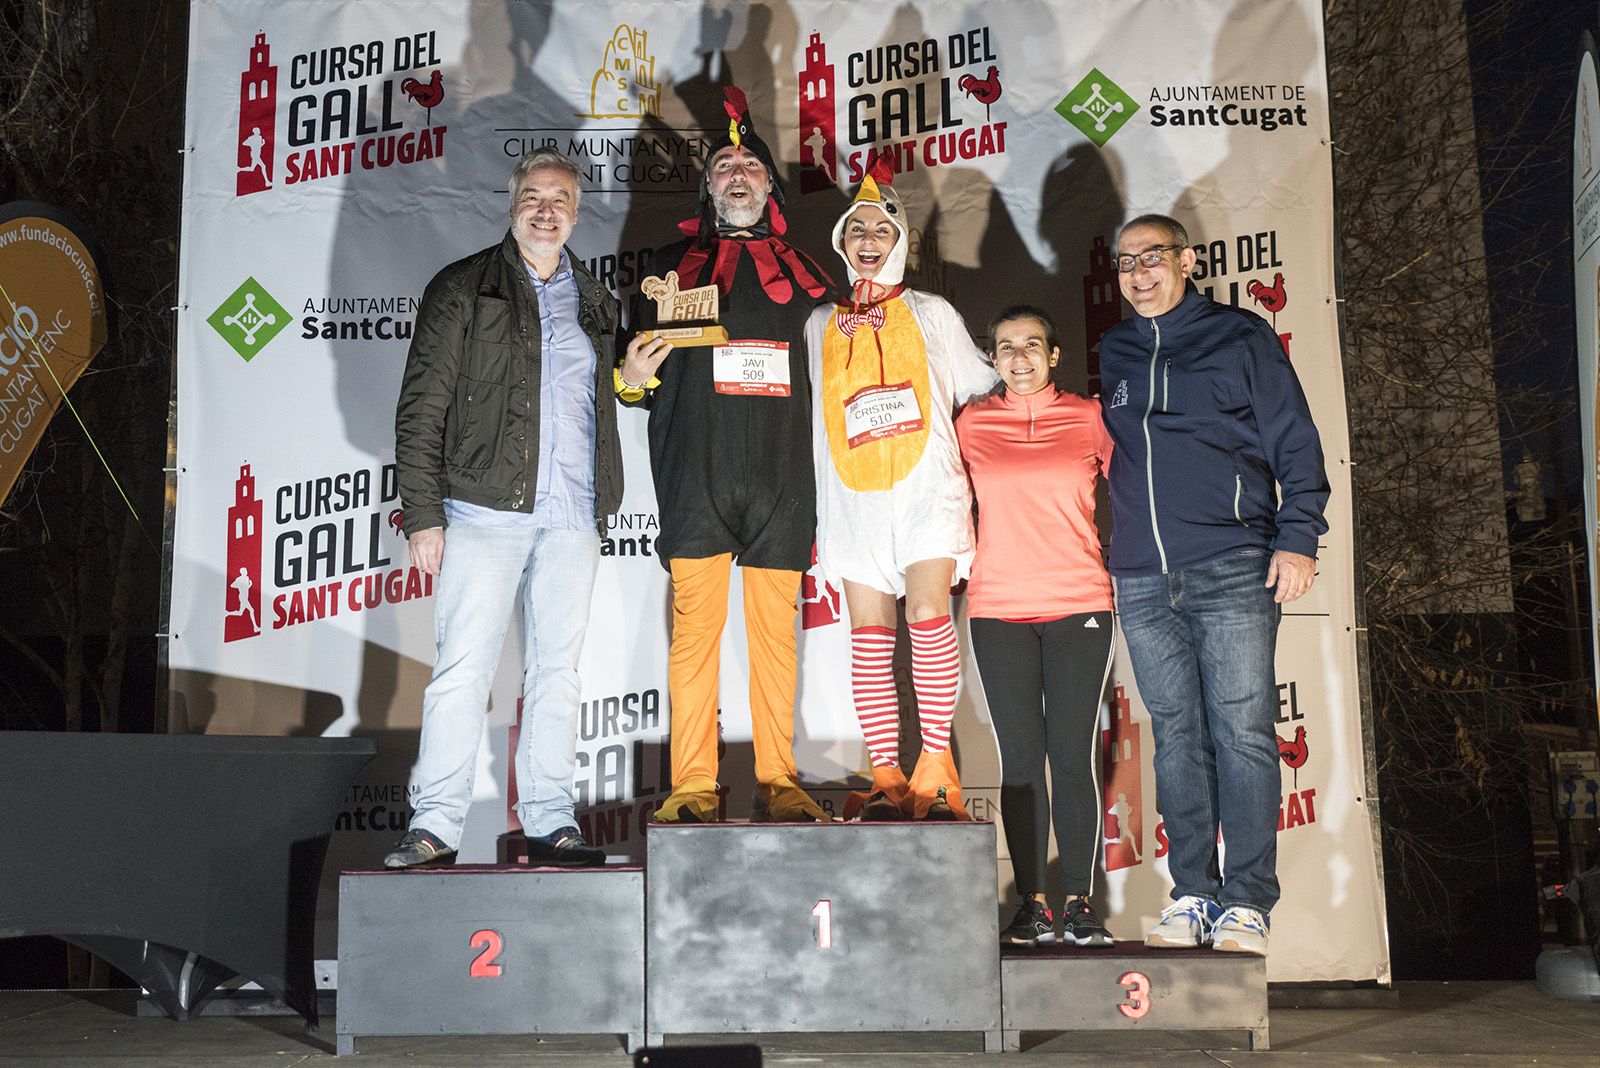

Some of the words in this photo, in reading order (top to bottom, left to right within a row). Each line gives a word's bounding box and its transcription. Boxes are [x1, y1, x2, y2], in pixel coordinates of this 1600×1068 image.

[290, 40, 384, 90] CURSA
[393, 30, 441, 72] DEL
[847, 38, 939, 89] CURSA
[948, 26, 997, 69] DEL
[287, 79, 404, 148] GALL
[848, 77, 963, 146] GALL
[1149, 103, 1307, 131] SantCugat
[1150, 85, 1276, 102] AJUNTAMENT
[1282, 85, 1306, 101] DE
[285, 142, 356, 185] SANT
[361, 125, 448, 170] CUGAT
[922, 121, 1007, 168] CUGAT
[614, 163, 694, 183] CUGAT
[1236, 230, 1283, 274] DEL
[671, 301, 716, 321] GALL
[673, 291, 700, 307] CURSA
[701, 289, 715, 302] DEL
[742, 358, 765, 368] JAVI
[742, 369, 765, 381] 509
[0, 384, 45, 453] CUGAT
[854, 401, 905, 420] CRISTINA
[870, 412, 893, 427] 510
[276, 468, 371, 525] CURSA
[274, 511, 391, 588] GALL
[272, 581, 343, 630] SANT
[811, 899, 830, 949] 1
[469, 929, 503, 978] 2
[1118, 971, 1151, 1019] 3
